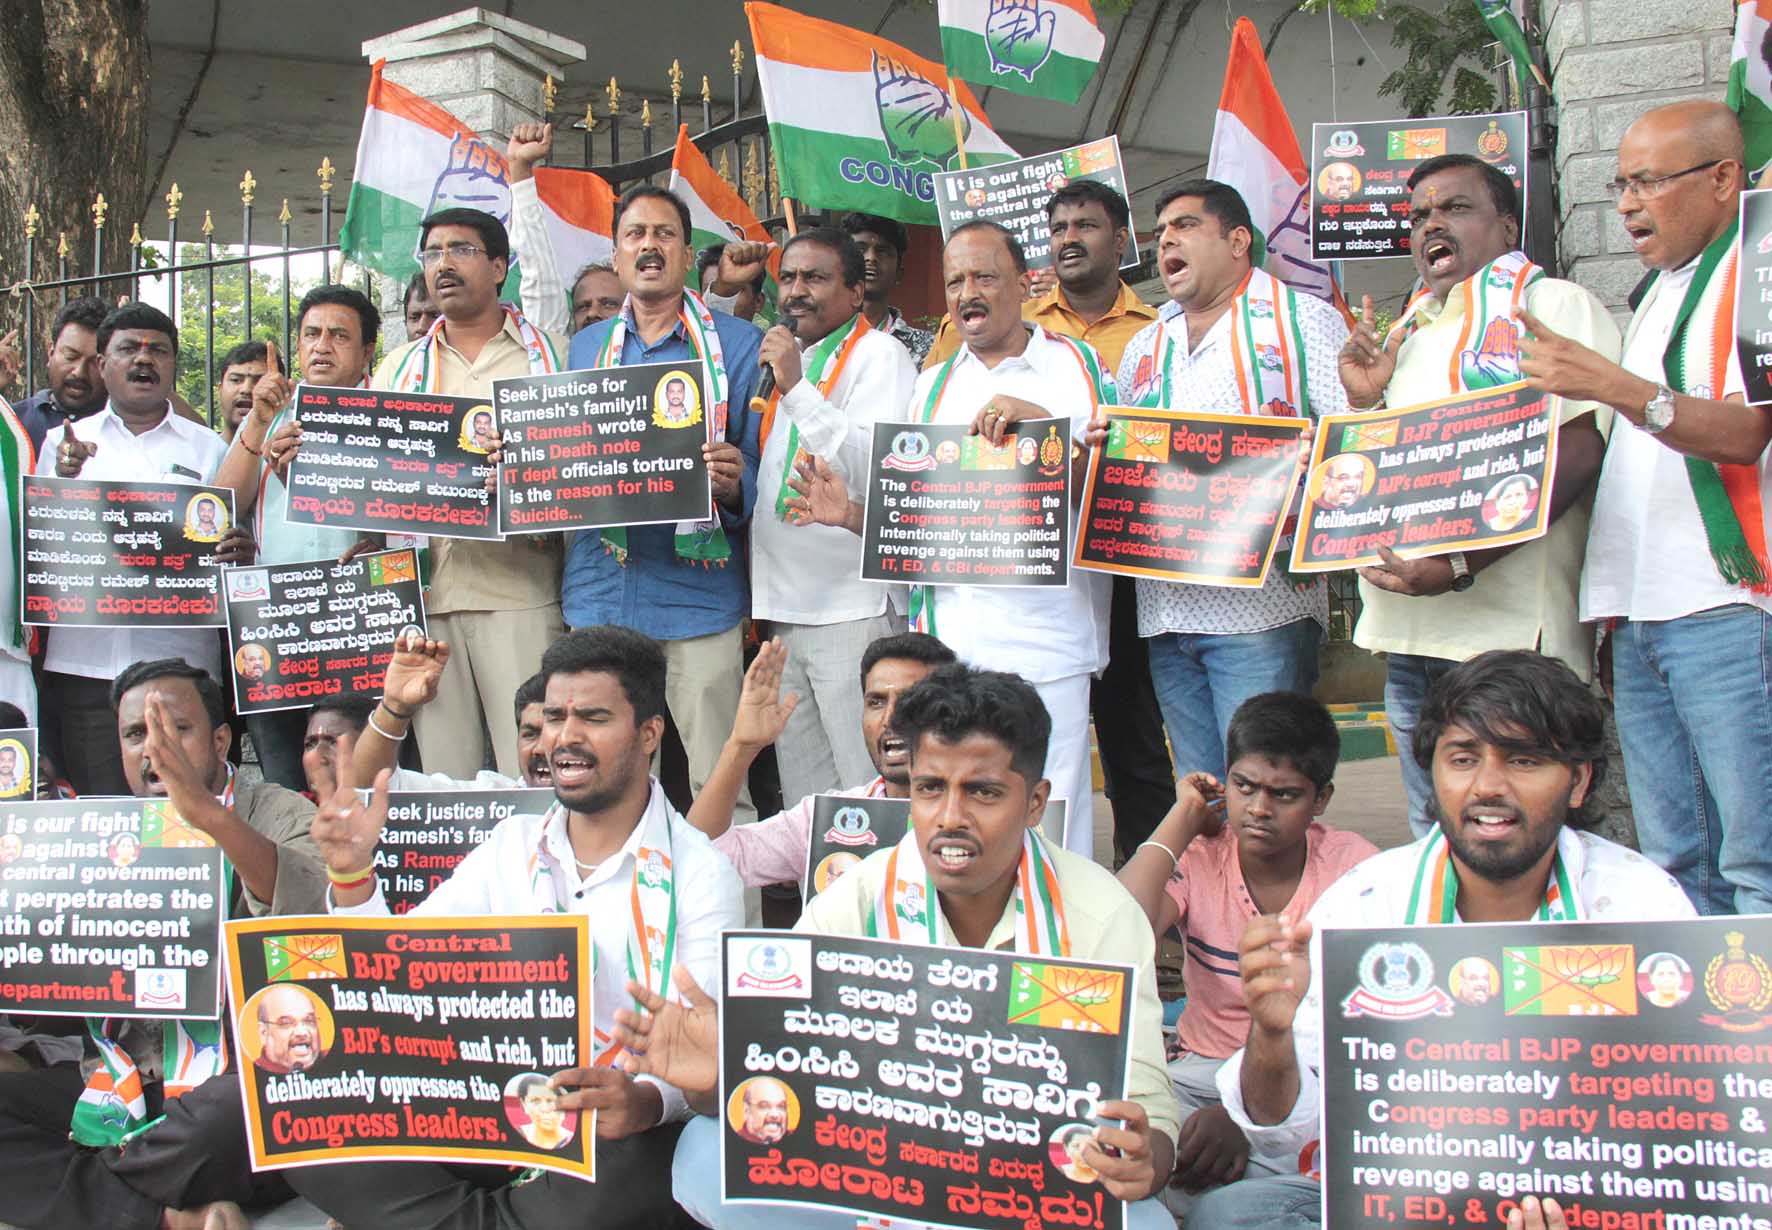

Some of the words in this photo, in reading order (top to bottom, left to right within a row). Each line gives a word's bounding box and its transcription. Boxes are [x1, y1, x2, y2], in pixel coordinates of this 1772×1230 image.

[840, 157, 935, 203] CONG
[946, 177, 965, 201] It
[969, 178, 984, 188] is
[990, 171, 1018, 185] our
[1023, 160, 1064, 179] fight
[986, 181, 1046, 204] against
[950, 210, 973, 220] the
[978, 198, 1028, 216] central
[500, 386, 538, 403] Seek
[542, 381, 597, 402] justice
[602, 378, 627, 392] for
[501, 402, 578, 424] Ramesh's
[583, 396, 646, 415] family!!
[1401, 422, 1439, 444] BJP
[1443, 397, 1548, 441] government
[1431, 394, 1515, 420] Central
[503, 428, 523, 443] As
[526, 421, 592, 441] Ramesh
[598, 418, 646, 434] wrote
[1378, 452, 1404, 468] has
[1406, 443, 1455, 464] always
[1456, 427, 1524, 459] protected
[1527, 418, 1548, 437] the
[504, 450, 517, 464] in
[522, 446, 545, 462] his
[549, 442, 597, 459] Death
[602, 439, 640, 454] note
[1463, 463, 1490, 480] and
[1490, 453, 1520, 475] rich,
[1523, 444, 1545, 467] but
[504, 468, 518, 484] IT
[522, 466, 558, 484] dept
[562, 460, 628, 478] officials
[633, 457, 693, 473] torture
[510, 490, 523, 504] is
[527, 488, 552, 502] the
[556, 484, 612, 500] reason
[617, 480, 642, 494] for
[648, 477, 674, 492] his
[880, 479, 906, 491] The
[911, 481, 960, 493] Central
[995, 480, 1064, 496] government
[510, 506, 582, 524] Suicide...
[884, 495, 896, 506] is
[901, 496, 980, 511] deliberately
[1042, 496, 1060, 508] the
[1315, 505, 1391, 528] deliberately
[1392, 497, 1457, 521] oppresses
[1460, 490, 1482, 508] the
[1046, 512, 1054, 524] &
[880, 526, 966, 543] intentionally
[970, 530, 1010, 544] taking
[1014, 528, 1059, 543] political
[1312, 527, 1397, 557] Congress
[1401, 517, 1476, 544] leaders.
[878, 544, 935, 558] revenge
[939, 546, 988, 560] against
[992, 546, 1024, 558] them
[1028, 546, 1060, 561] using
[882, 558, 898, 572] IT,
[946, 561, 970, 573] CBI
[310, 613, 356, 634] ಅವರ
[365, 604, 415, 628] ಸಾವಿಗೆ
[6, 815, 26, 832] is
[33, 817, 75, 834] our
[80, 812, 140, 837] fight
[388, 803, 421, 820] eek
[425, 802, 484, 824] justice
[489, 802, 515, 818] for
[380, 826, 464, 844] Ramesh's
[23, 838, 109, 862] against
[372, 850, 398, 868] As
[1, 864, 75, 880] central
[80, 864, 210, 884] government
[396, 875, 424, 892] his
[16, 889, 162, 913] perpetrates
[170, 889, 213, 909] the
[38, 914, 64, 936] of
[72, 914, 190, 937] innocent
[50, 943, 155, 970] through
[163, 945, 208, 966] the
[386, 933, 512, 952] Central
[352, 952, 400, 980] BJP
[408, 954, 568, 990] government
[816, 952, 913, 982] ಆದಾಯ
[928, 960, 998, 992] ತೆರಿಗೆ
[331, 984, 368, 1011] has
[372, 986, 434, 1022] always
[438, 990, 534, 1024] protected
[539, 989, 575, 1018] the
[838, 986, 917, 1016] ಇಲಾಖೆ
[931, 996, 972, 1024] ಯ
[784, 1006, 899, 1045] ಮೂಲಕ
[342, 1027, 391, 1054] BJP's
[394, 1035, 457, 1065] corrupt
[460, 1036, 493, 1062] and
[495, 1036, 537, 1070] rich,
[541, 1037, 575, 1066] but
[1342, 1038, 1397, 1060] The
[1406, 1038, 1510, 1061] Central
[1520, 1038, 1580, 1062] BJP
[1591, 1044, 1772, 1068] governmen
[266, 1070, 376, 1104] deliberately
[380, 1072, 467, 1104] oppresses
[470, 1076, 500, 1102] the
[744, 1044, 860, 1078] ಹಿಂಸಿಸಿ
[878, 1060, 963, 1097] ಅವರ
[983, 1078, 1106, 1123] ಸಾವಿಗೆ
[1356, 1068, 1379, 1091] is
[1388, 1069, 1560, 1100] deliberately
[1568, 1072, 1715, 1103] targeting
[1724, 1073, 1772, 1098] the
[272, 1110, 399, 1148] Congress
[404, 1105, 507, 1142] leaders.
[816, 1087, 1040, 1151] ಕಾರಣವಾಗುತ್ತಿರುವ
[1369, 1100, 1510, 1132] Congress
[1520, 1105, 1598, 1133] party
[1609, 1104, 1729, 1132] leaders
[1740, 1108, 1766, 1132] &
[816, 1114, 887, 1166] ಕೇಂದ್ರ
[1354, 1131, 1534, 1164] intentionally
[1543, 1136, 1642, 1168] taking
[1654, 1140, 1772, 1169] politica
[748, 1149, 924, 1206] ಹೋರಾಟ
[1354, 1168, 1470, 1194] revenge
[1478, 1168, 1593, 1197] against
[1601, 1171, 1685, 1199] them
[1696, 1176, 1772, 1204] usin
[1364, 1194, 1396, 1222] IT,
[1404, 1195, 1454, 1224] ED,
[1465, 1199, 1488, 1222] &
